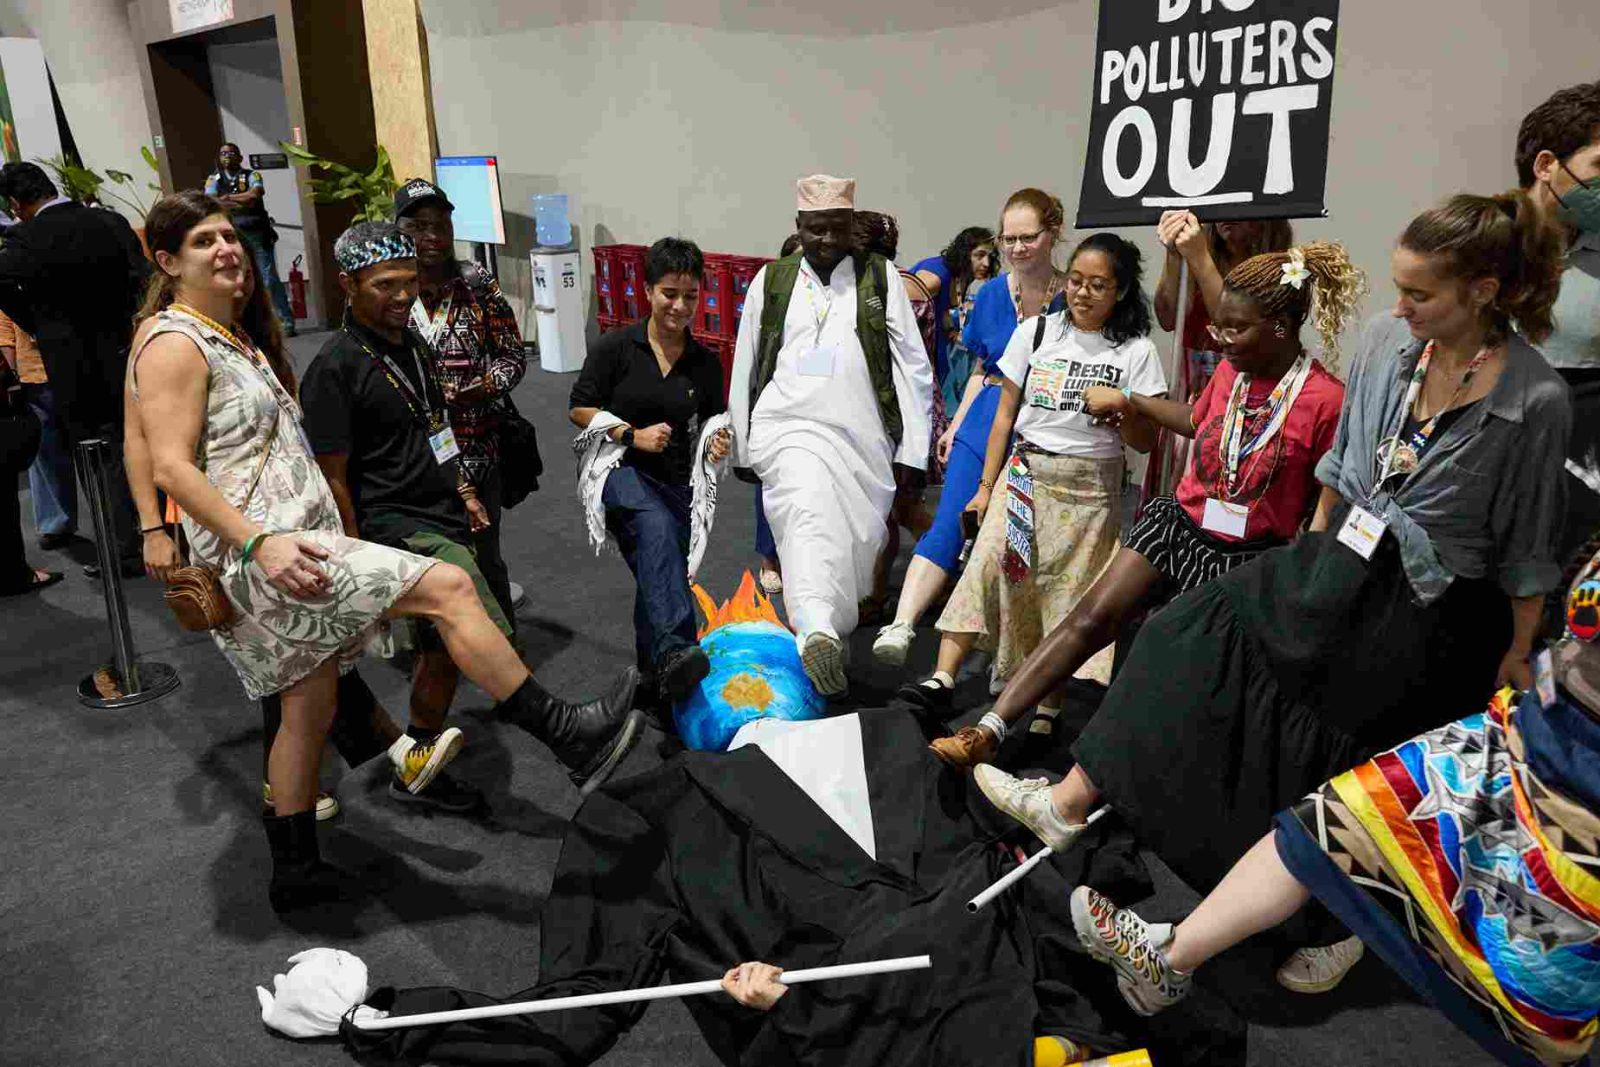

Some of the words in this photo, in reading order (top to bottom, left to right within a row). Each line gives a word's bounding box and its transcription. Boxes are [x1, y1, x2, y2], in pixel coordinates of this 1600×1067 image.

[1100, 17, 1333, 104] POLLUTERS
[1102, 84, 1319, 198] OUT
[563, 276, 574, 288] 53
[1068, 361, 1123, 384] RESIST
[1010, 497, 1029, 520] THE
